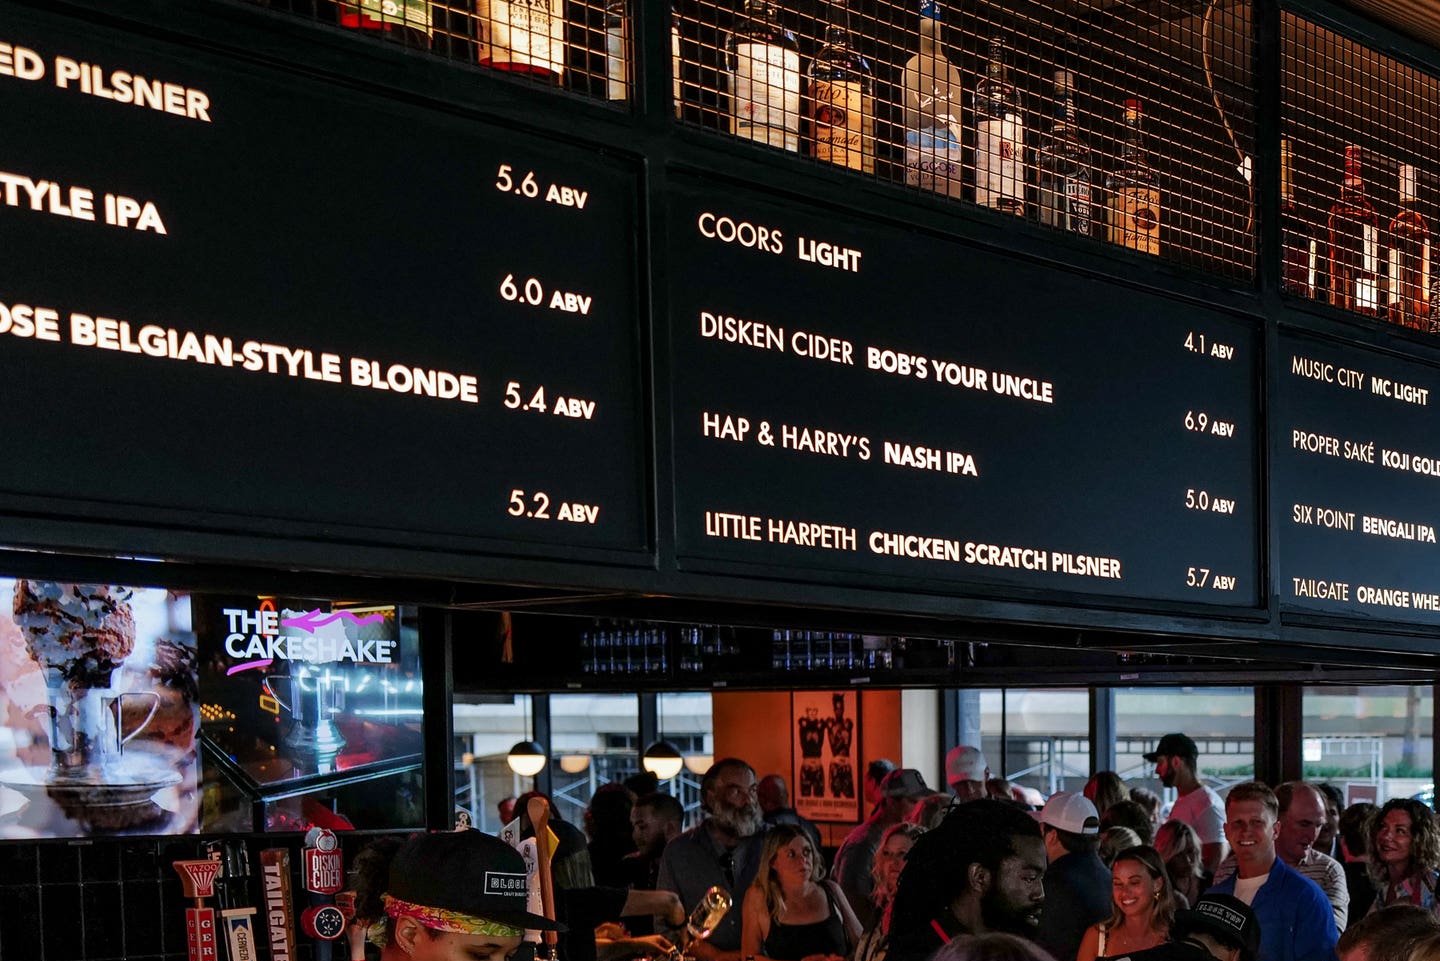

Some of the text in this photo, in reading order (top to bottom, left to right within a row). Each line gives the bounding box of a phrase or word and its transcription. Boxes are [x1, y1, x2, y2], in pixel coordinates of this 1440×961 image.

[56, 57, 211, 121] PILSNER
[0, 172, 167, 234] TYLE IPA
[496, 165, 587, 208] 5.6 ABV
[500, 274, 591, 314] 6.0 ABV
[699, 213, 1233, 360] COORS LIGHT 4.1 ABV
[71, 313, 341, 382] BELGIAN-STYLE
[351, 358, 478, 402] BLONDE
[504, 382, 546, 412] 5.4
[554, 397, 595, 419] ABV
[702, 312, 1234, 437] DISKEN CIDER BOB'S YOUR UNCLE 6.9 ABV
[1293, 356, 1333, 382] MUSIC
[1338, 368, 1364, 389] CITY
[1372, 377, 1391, 396] MC
[1395, 383, 1428, 405] LIGHT
[704, 412, 1235, 514] HAP & HARRY'S NASH IPA 5.0 ABV
[1294, 430, 1339, 456] PROPER
[1344, 441, 1374, 463] SAKÉ
[1382, 449, 1409, 470] KOJI
[509, 490, 599, 523] 5.2 ABV
[1294, 504, 1312, 524] SIX
[1317, 508, 1355, 530] POINT
[1363, 516, 1414, 540] BENGALI
[1418, 525, 1436, 543] IPA
[706, 512, 1235, 590] LITTLE HARPETH CHICKEN SCRATCH PILSNER 5.7 ABV
[1293, 578, 1348, 601] TAILGATE
[1357, 586, 1409, 607] ORANGE
[223, 608, 279, 635] THE
[187, 864, 218, 873] YAZOO
[312, 870, 341, 889] CIDER
